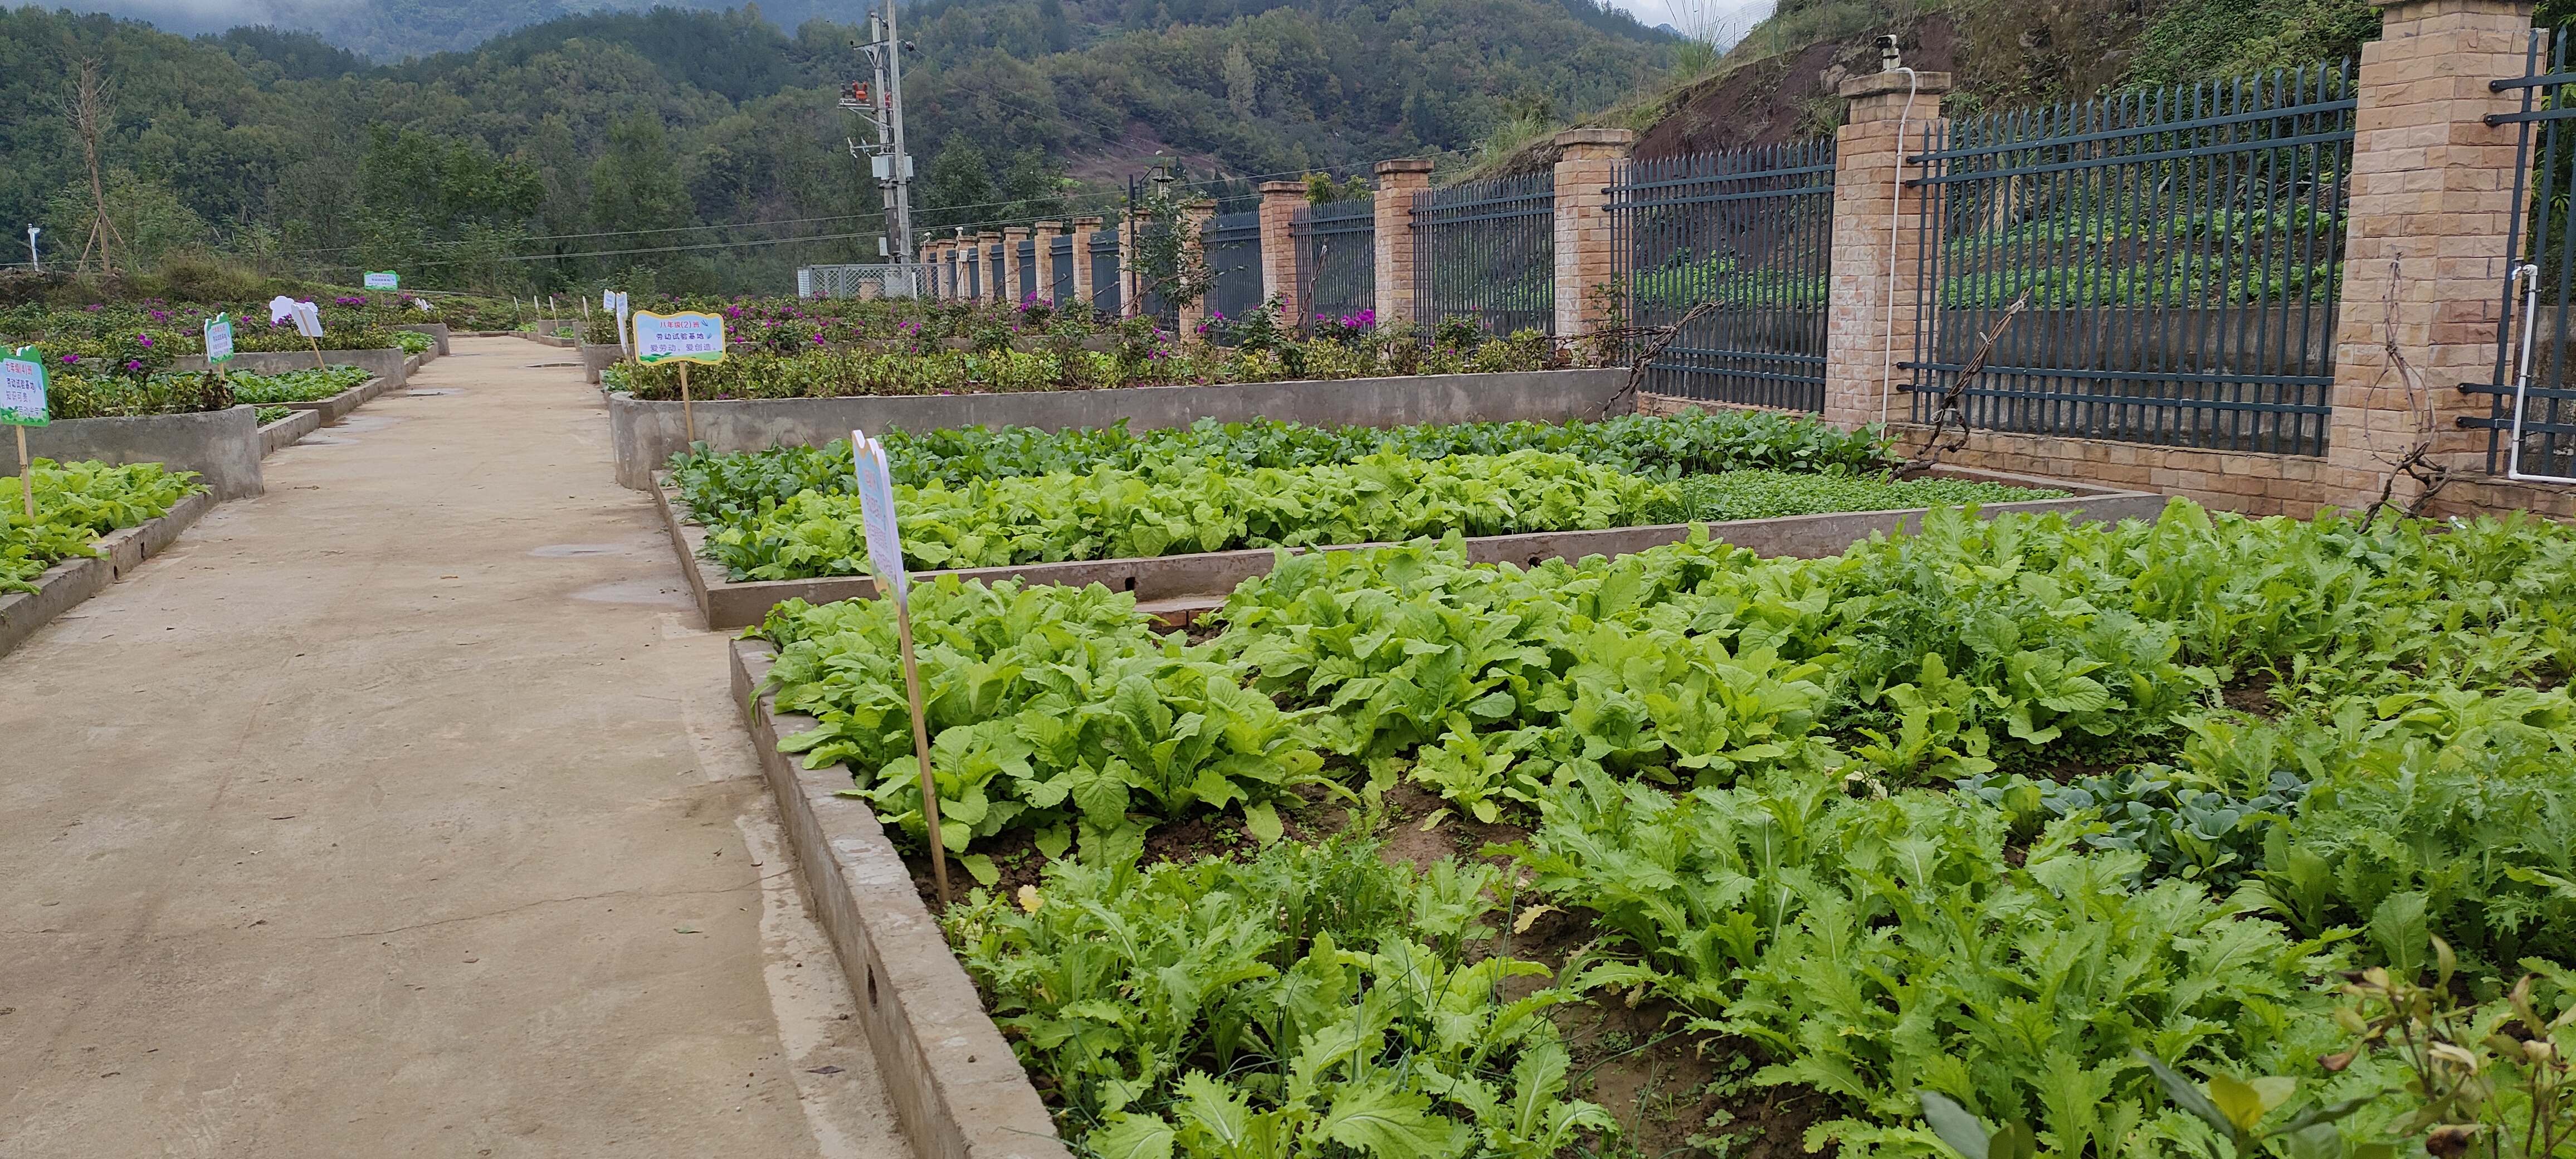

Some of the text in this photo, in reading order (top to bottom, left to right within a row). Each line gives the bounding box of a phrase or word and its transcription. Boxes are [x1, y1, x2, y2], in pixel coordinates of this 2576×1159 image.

[5, 361, 33, 376] 七年级(4)班
[6, 378, 35, 391] 劳动试验基地
